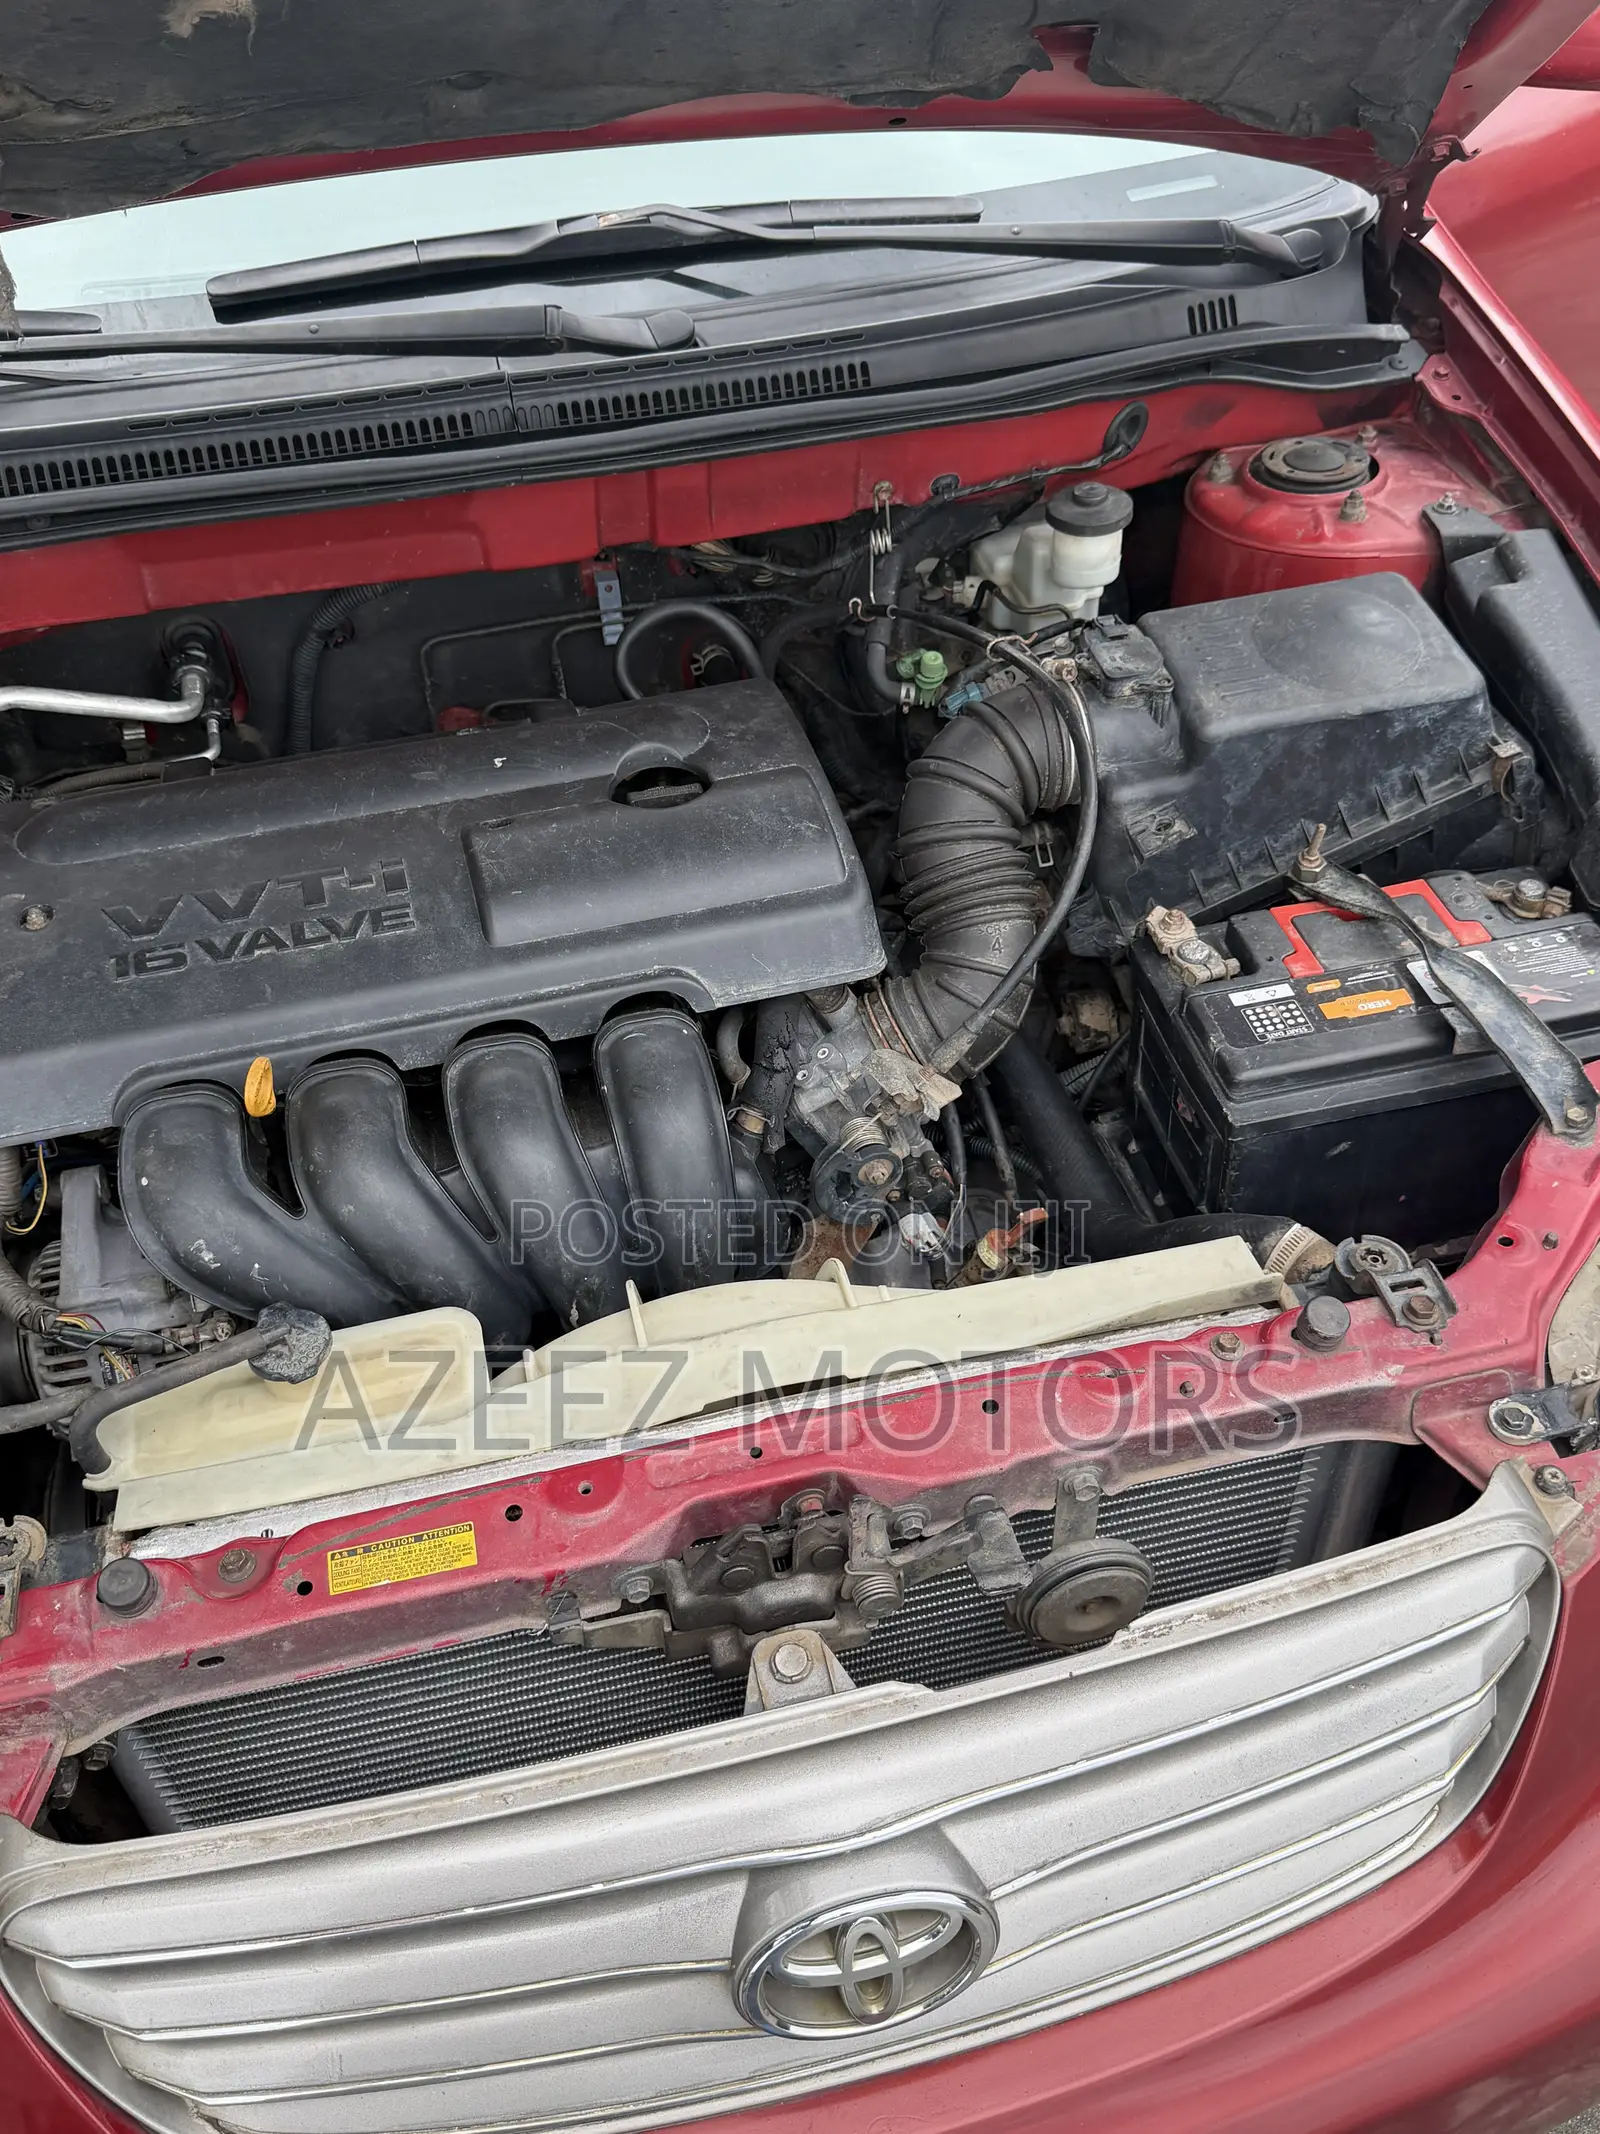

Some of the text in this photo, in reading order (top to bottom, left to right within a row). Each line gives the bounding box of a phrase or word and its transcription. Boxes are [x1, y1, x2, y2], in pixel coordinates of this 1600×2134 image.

[109, 901, 417, 984] 16 VALVE
[1357, 999, 1392, 1011] HERO
[370, 1524, 470, 1551] CAUTION ATTENTION
